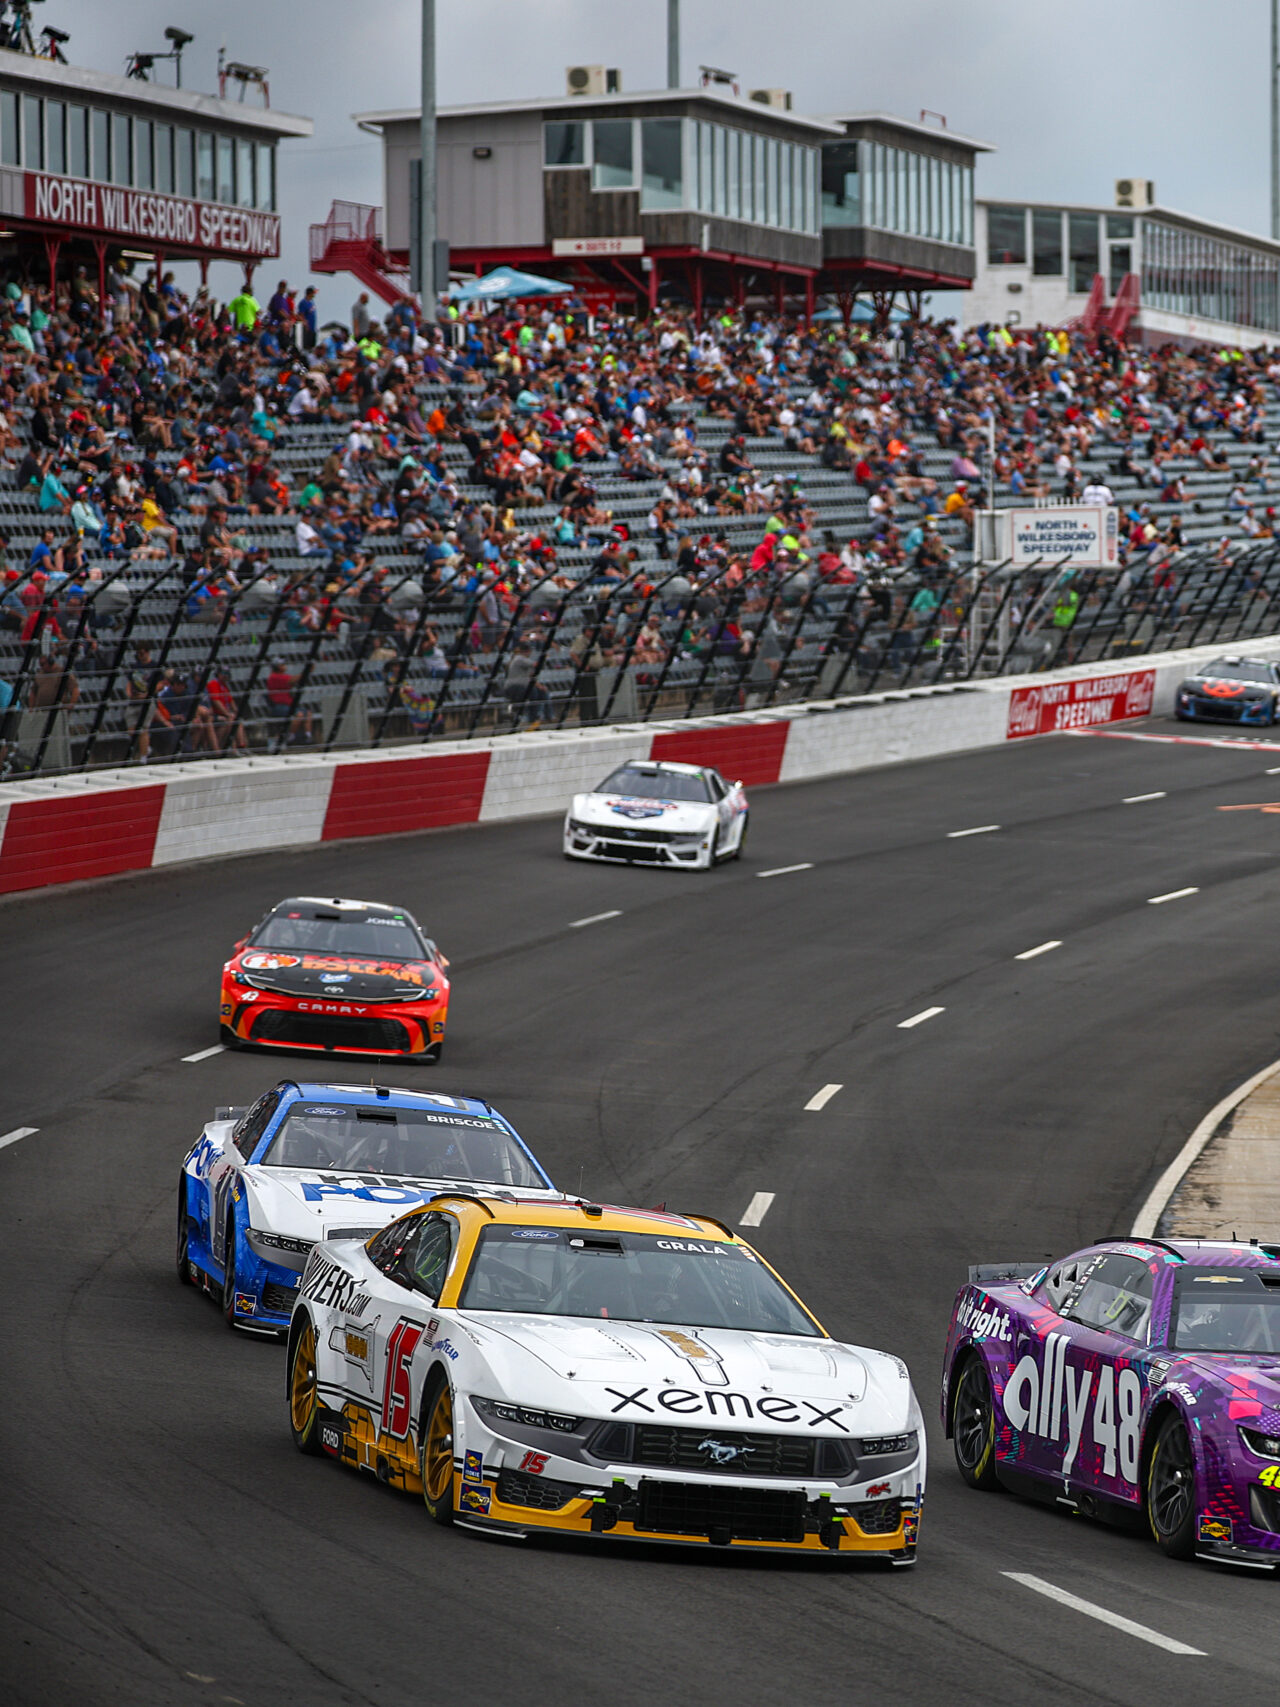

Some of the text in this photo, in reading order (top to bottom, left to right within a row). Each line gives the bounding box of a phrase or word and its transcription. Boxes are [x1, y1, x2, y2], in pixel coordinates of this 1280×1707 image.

[35, 177, 279, 255] NORTH WILKESBORO SPEEDWAY
[1017, 531, 1096, 542] WILKESBORO
[1035, 520, 1078, 530] NORTH
[1023, 543, 1091, 553] SPEEDWAY
[1055, 698, 1114, 728] SPEEDWAY
[365, 916, 406, 928] JONES
[301, 960, 423, 987] DOLLAR
[298, 1002, 367, 1014] CAMRY
[427, 1115, 495, 1129] BRISCOE
[656, 1240, 729, 1256] GRALA
[968, 1302, 1012, 1342] right.
[381, 1315, 427, 1443] 15
[604, 1387, 850, 1433] xemex
[1003, 1332, 1141, 1485] ally 48
[322, 1427, 339, 1450] FORD
[519, 1450, 551, 1475] 15
